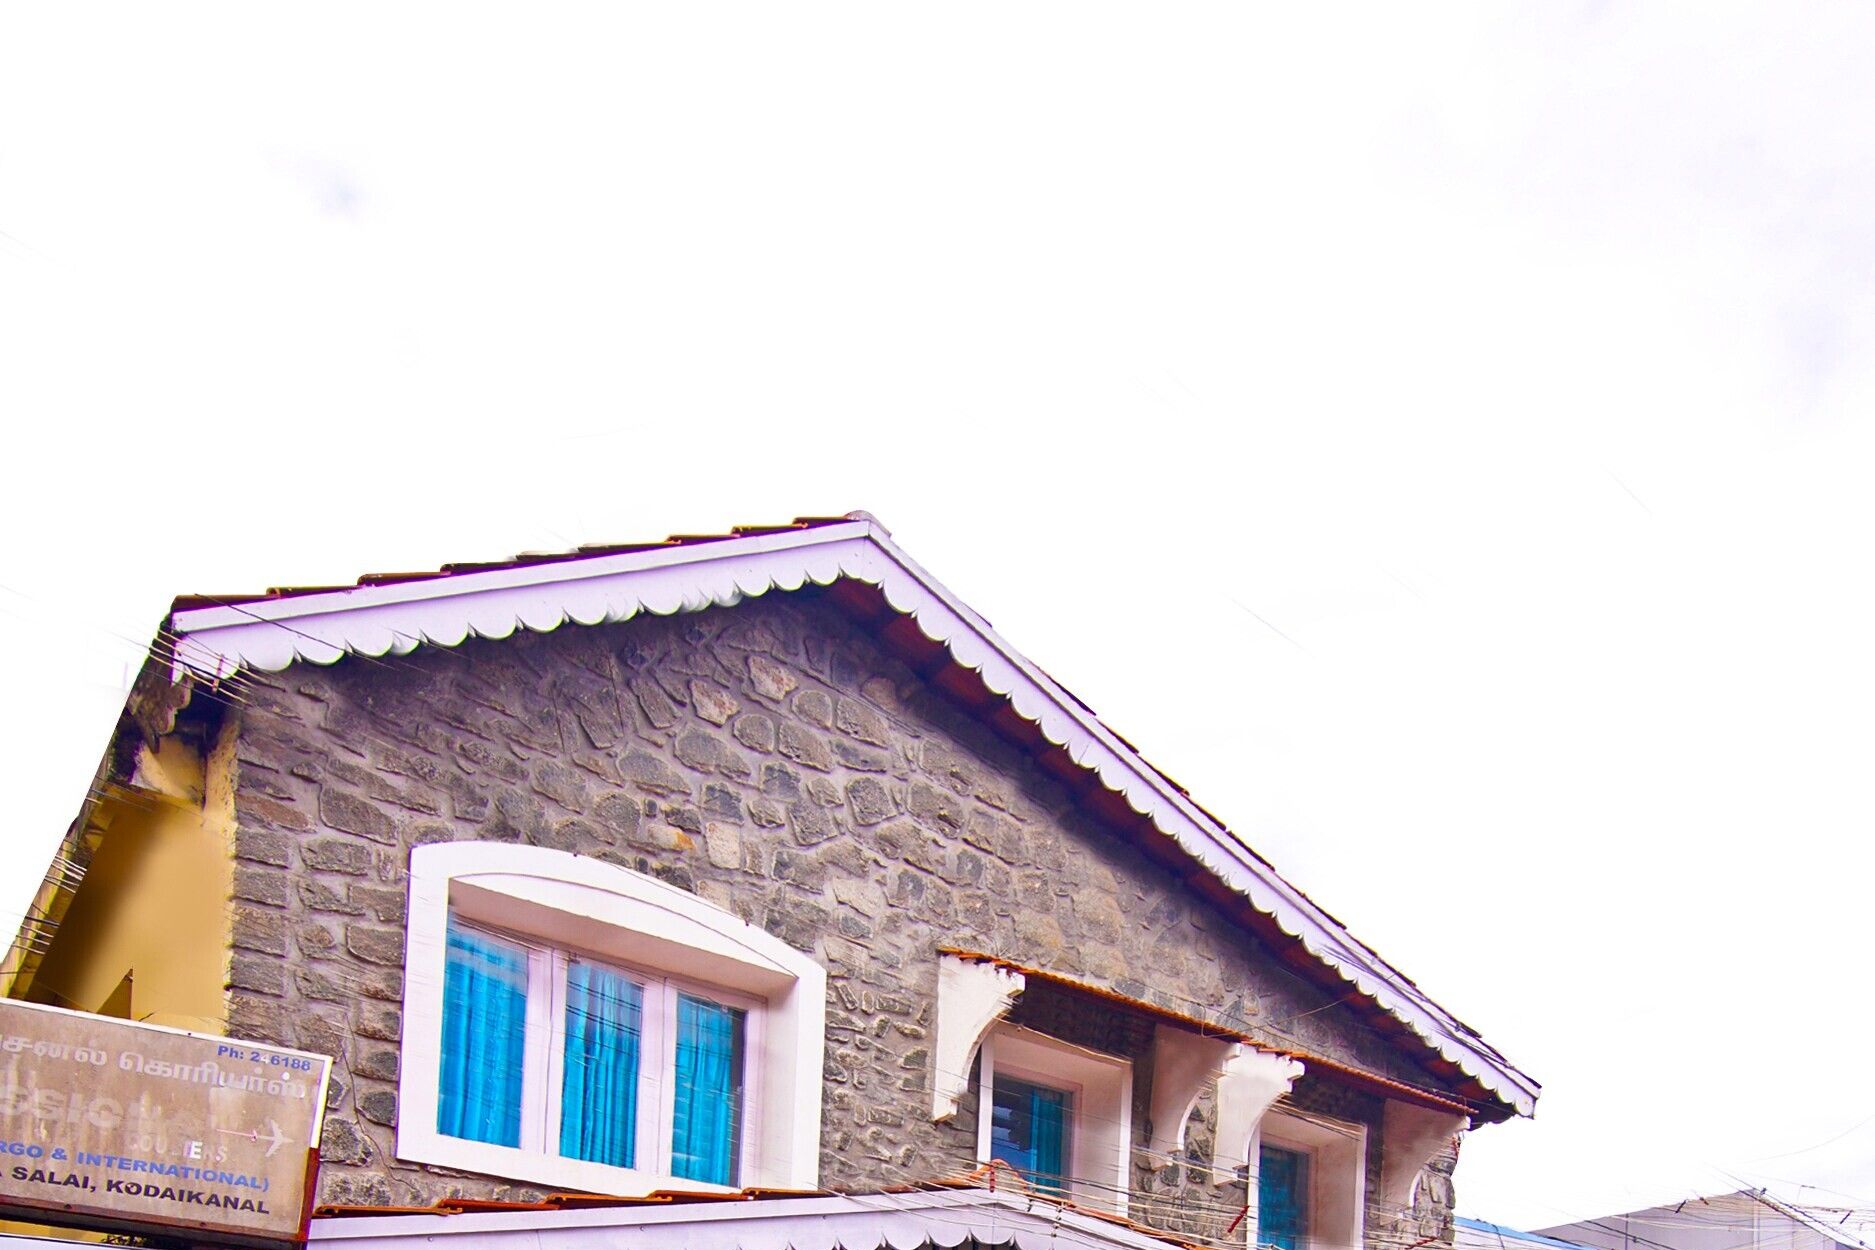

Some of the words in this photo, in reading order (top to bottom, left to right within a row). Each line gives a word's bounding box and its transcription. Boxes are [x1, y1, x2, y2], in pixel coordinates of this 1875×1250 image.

[217, 1045, 244, 1061] Ph:
[251, 1050, 312, 1072] 246188
[12, 1166, 97, 1193] SALAI,
[106, 1179, 270, 1215] KODAIKANAL
[51, 1147, 68, 1161] &
[77, 1151, 270, 1192] INTERNATIONAL)
